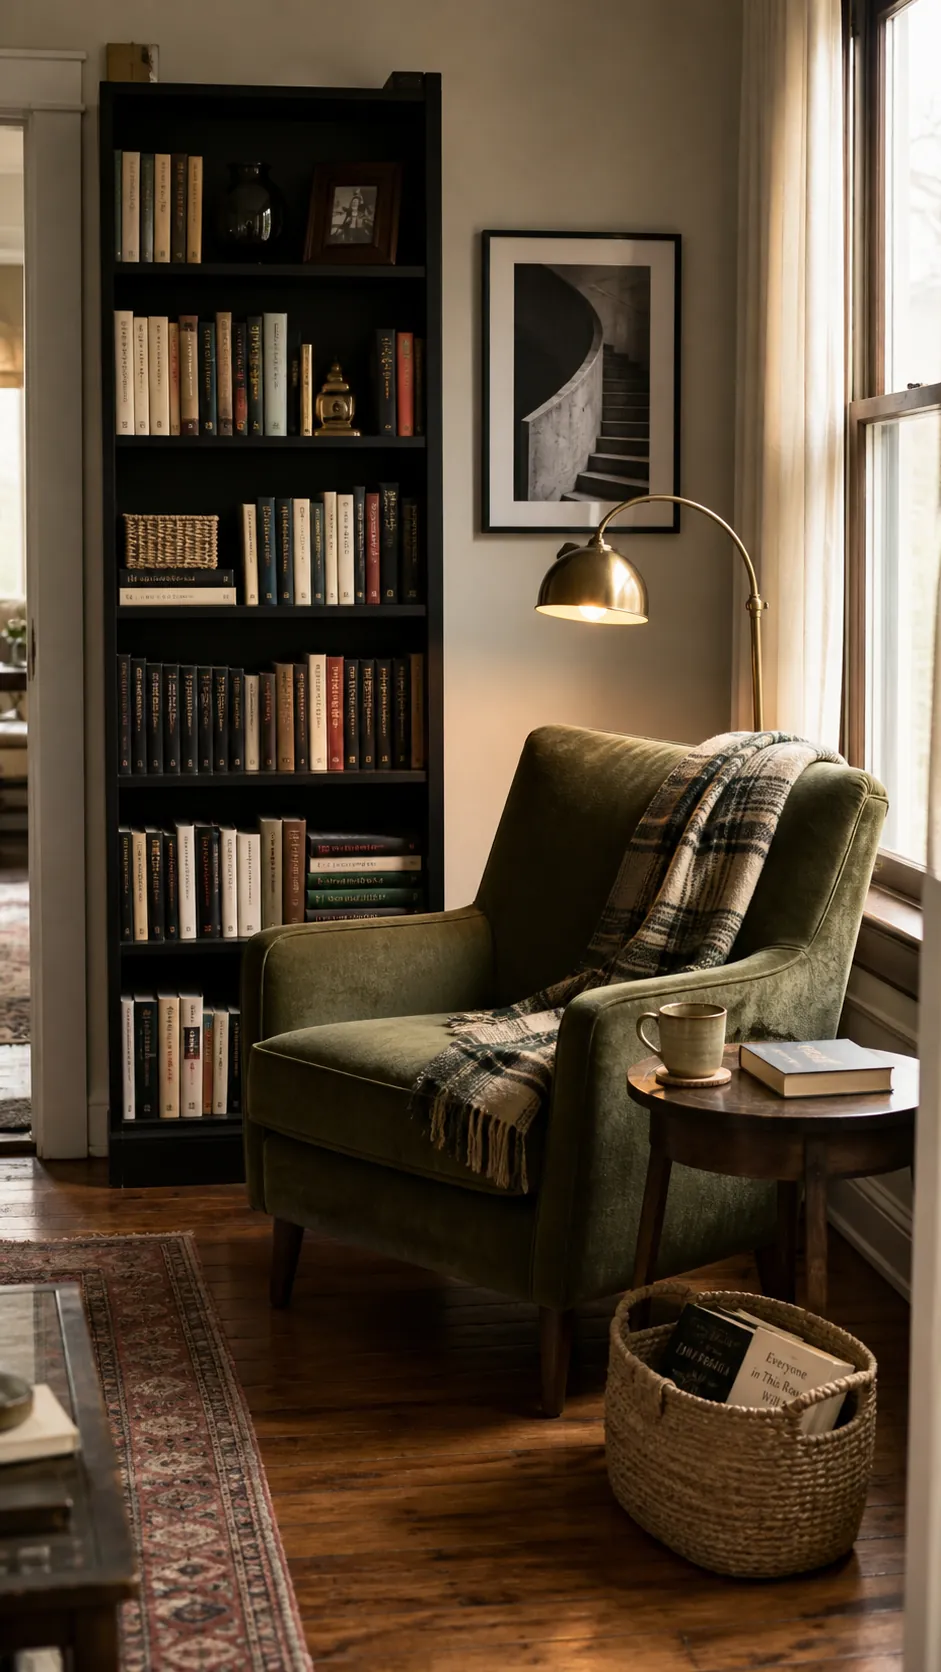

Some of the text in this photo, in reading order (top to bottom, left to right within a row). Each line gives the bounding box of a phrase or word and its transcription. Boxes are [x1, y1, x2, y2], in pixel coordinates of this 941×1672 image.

[750, 1367, 760, 1379] in
[762, 1370, 780, 1389] This
[762, 1390, 780, 1407] Will
